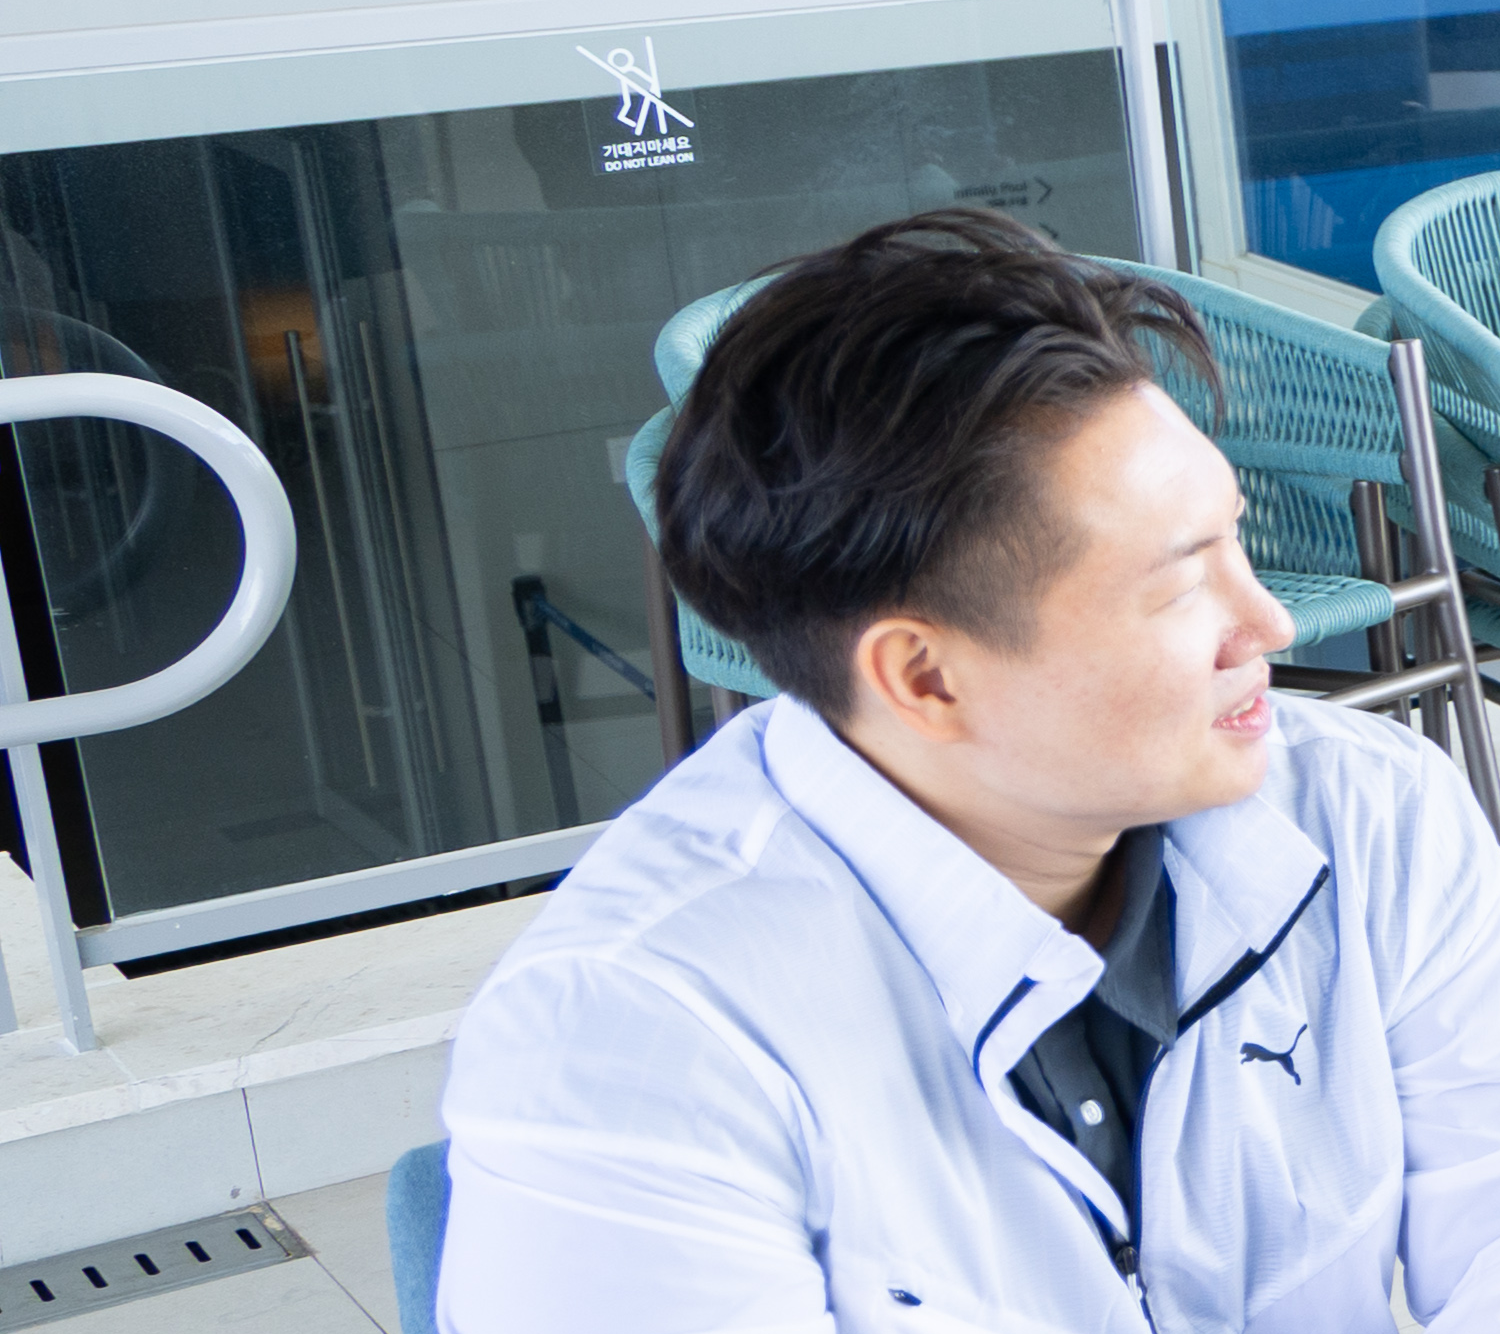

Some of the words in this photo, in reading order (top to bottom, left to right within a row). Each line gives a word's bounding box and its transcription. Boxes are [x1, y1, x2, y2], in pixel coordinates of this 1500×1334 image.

[603, 136, 691, 158] 기대지마세요
[605, 159, 622, 172] DO
[623, 157, 646, 170] NOT
[648, 154, 676, 168] LEAN
[676, 152, 694, 164] ON
